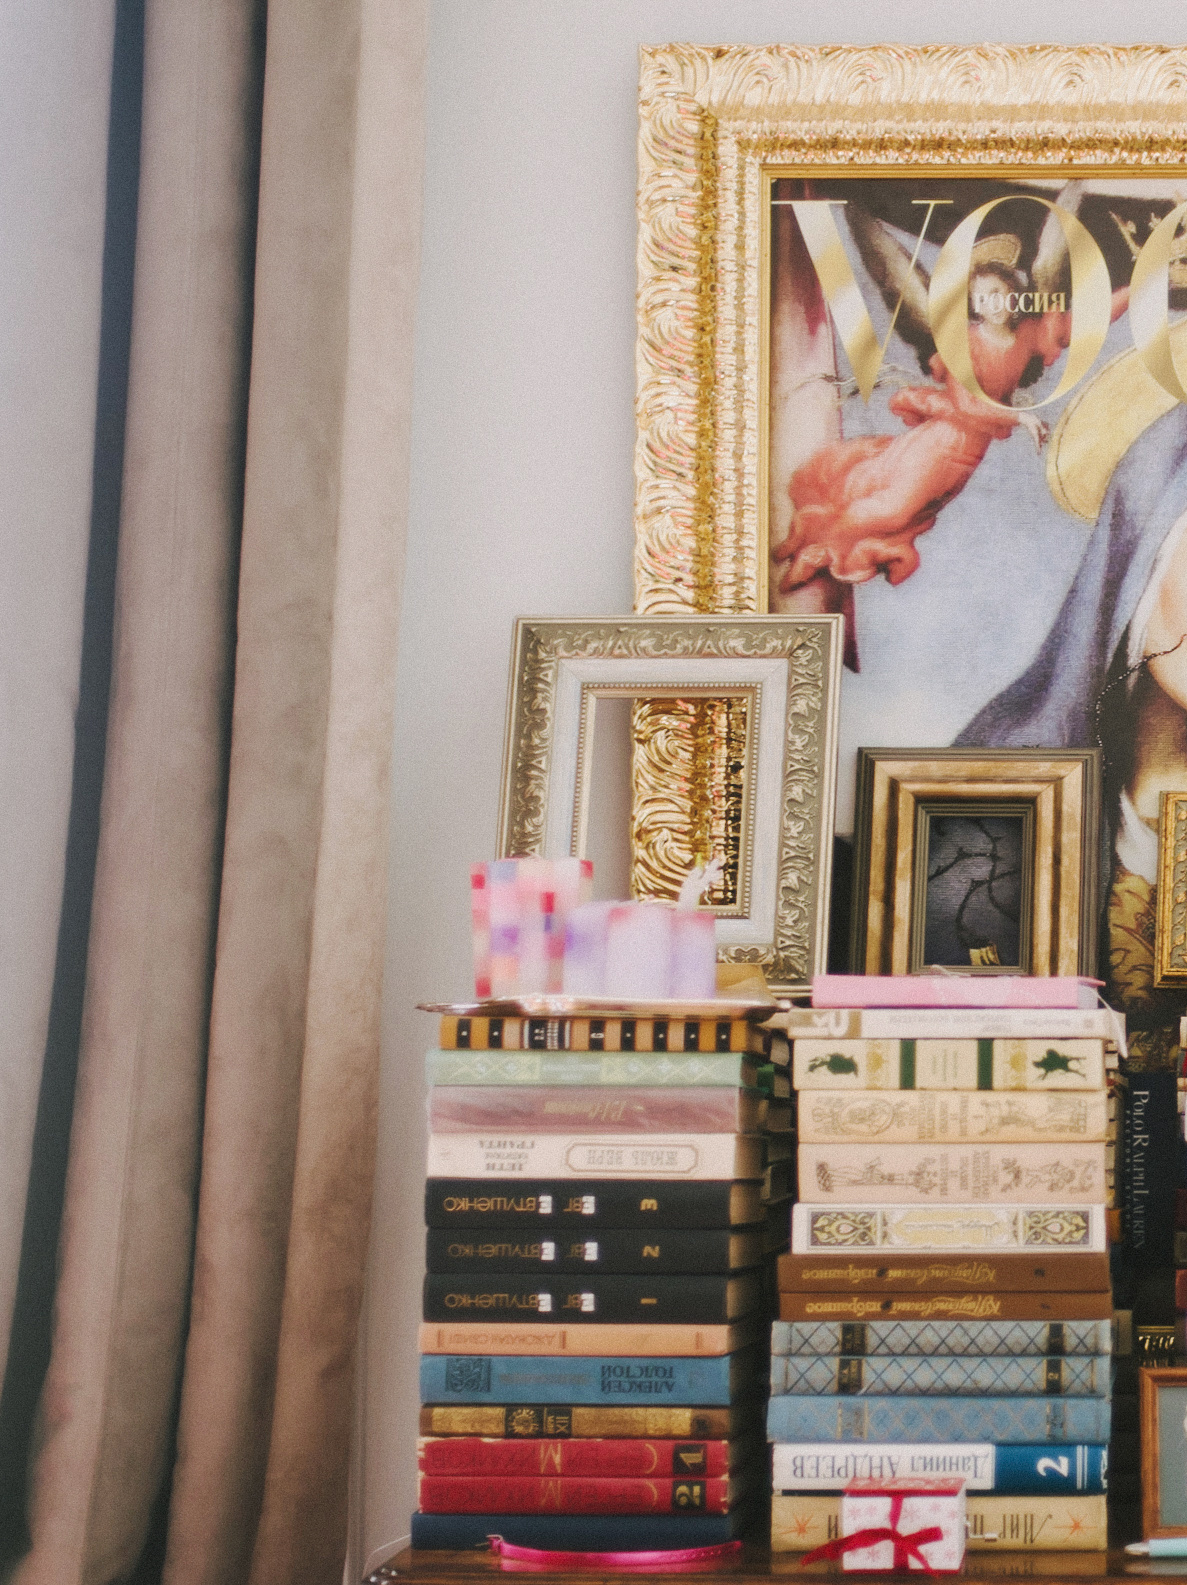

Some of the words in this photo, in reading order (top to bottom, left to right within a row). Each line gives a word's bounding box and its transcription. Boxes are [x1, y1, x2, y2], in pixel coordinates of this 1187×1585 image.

[974, 291, 1066, 313] РОССИЯ
[600, 1365, 674, 1379] ТОЛСТОЙ
[600, 1380, 675, 1396] АЛЕКСЕЙ
[790, 1453, 900, 1480] АНДРЕЕВ
[909, 1453, 990, 1480] Даниил
[1036, 1455, 1069, 1477] 2
[674, 1484, 700, 1506] 2
